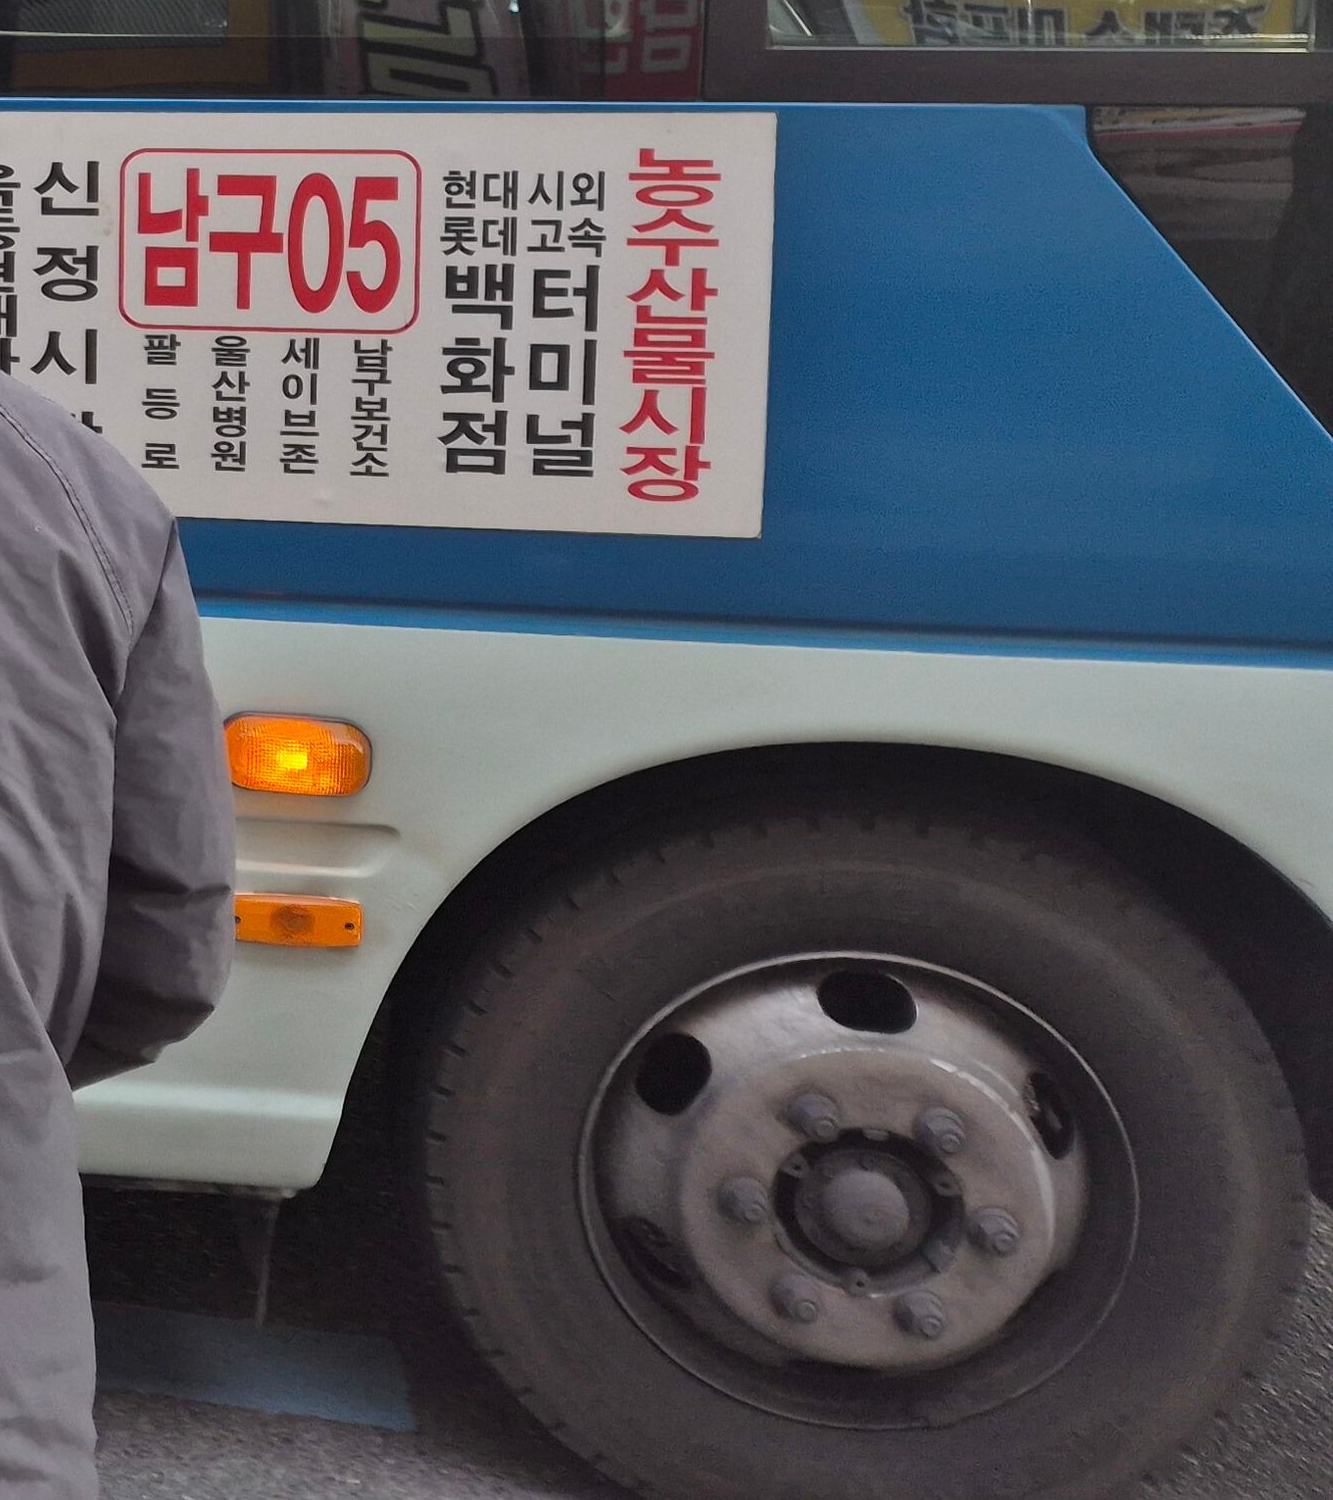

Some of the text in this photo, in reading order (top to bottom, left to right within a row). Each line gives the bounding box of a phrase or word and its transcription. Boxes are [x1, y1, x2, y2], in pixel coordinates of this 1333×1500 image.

[138, 167, 402, 315] 남구05
[439, 215, 518, 257] 롯데
[442, 169, 520, 211] 현대
[526, 216, 608, 258] 고속
[527, 170, 607, 212] 시외
[30, 161, 104, 433] 신정시
[618, 147, 722, 503] 농수산물시장
[141, 333, 182, 470] 팔등로
[210, 335, 252, 472] 울산병원
[279, 337, 321, 475] 세이브존
[349, 339, 393, 478] 남구보건소
[437, 263, 516, 476] 백화점
[525, 264, 601, 478] 터미널
